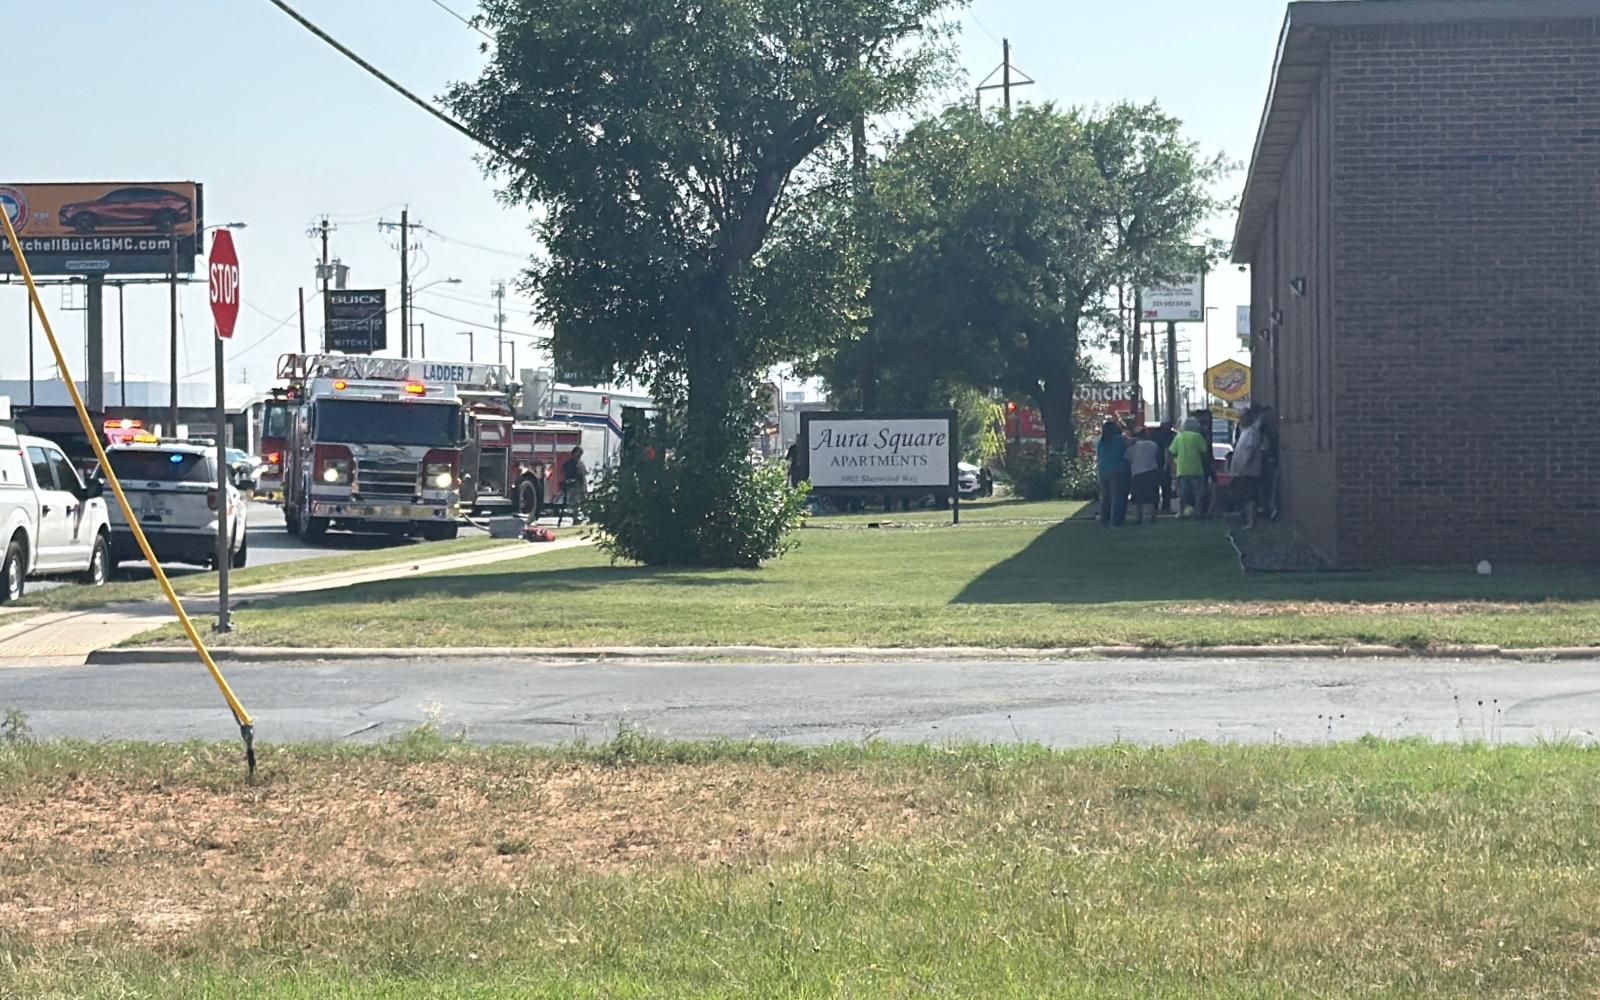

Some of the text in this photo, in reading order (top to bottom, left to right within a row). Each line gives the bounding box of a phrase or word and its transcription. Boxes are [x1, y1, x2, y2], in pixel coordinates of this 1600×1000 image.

[2, 238, 171, 251] MtchellBuickGMC.com
[209, 263, 239, 305] STOP
[331, 295, 381, 304] BUICK
[423, 364, 474, 382] LADDER 7
[812, 428, 946, 454] Aura Square
[830, 455, 928, 467] APARTMENTS
